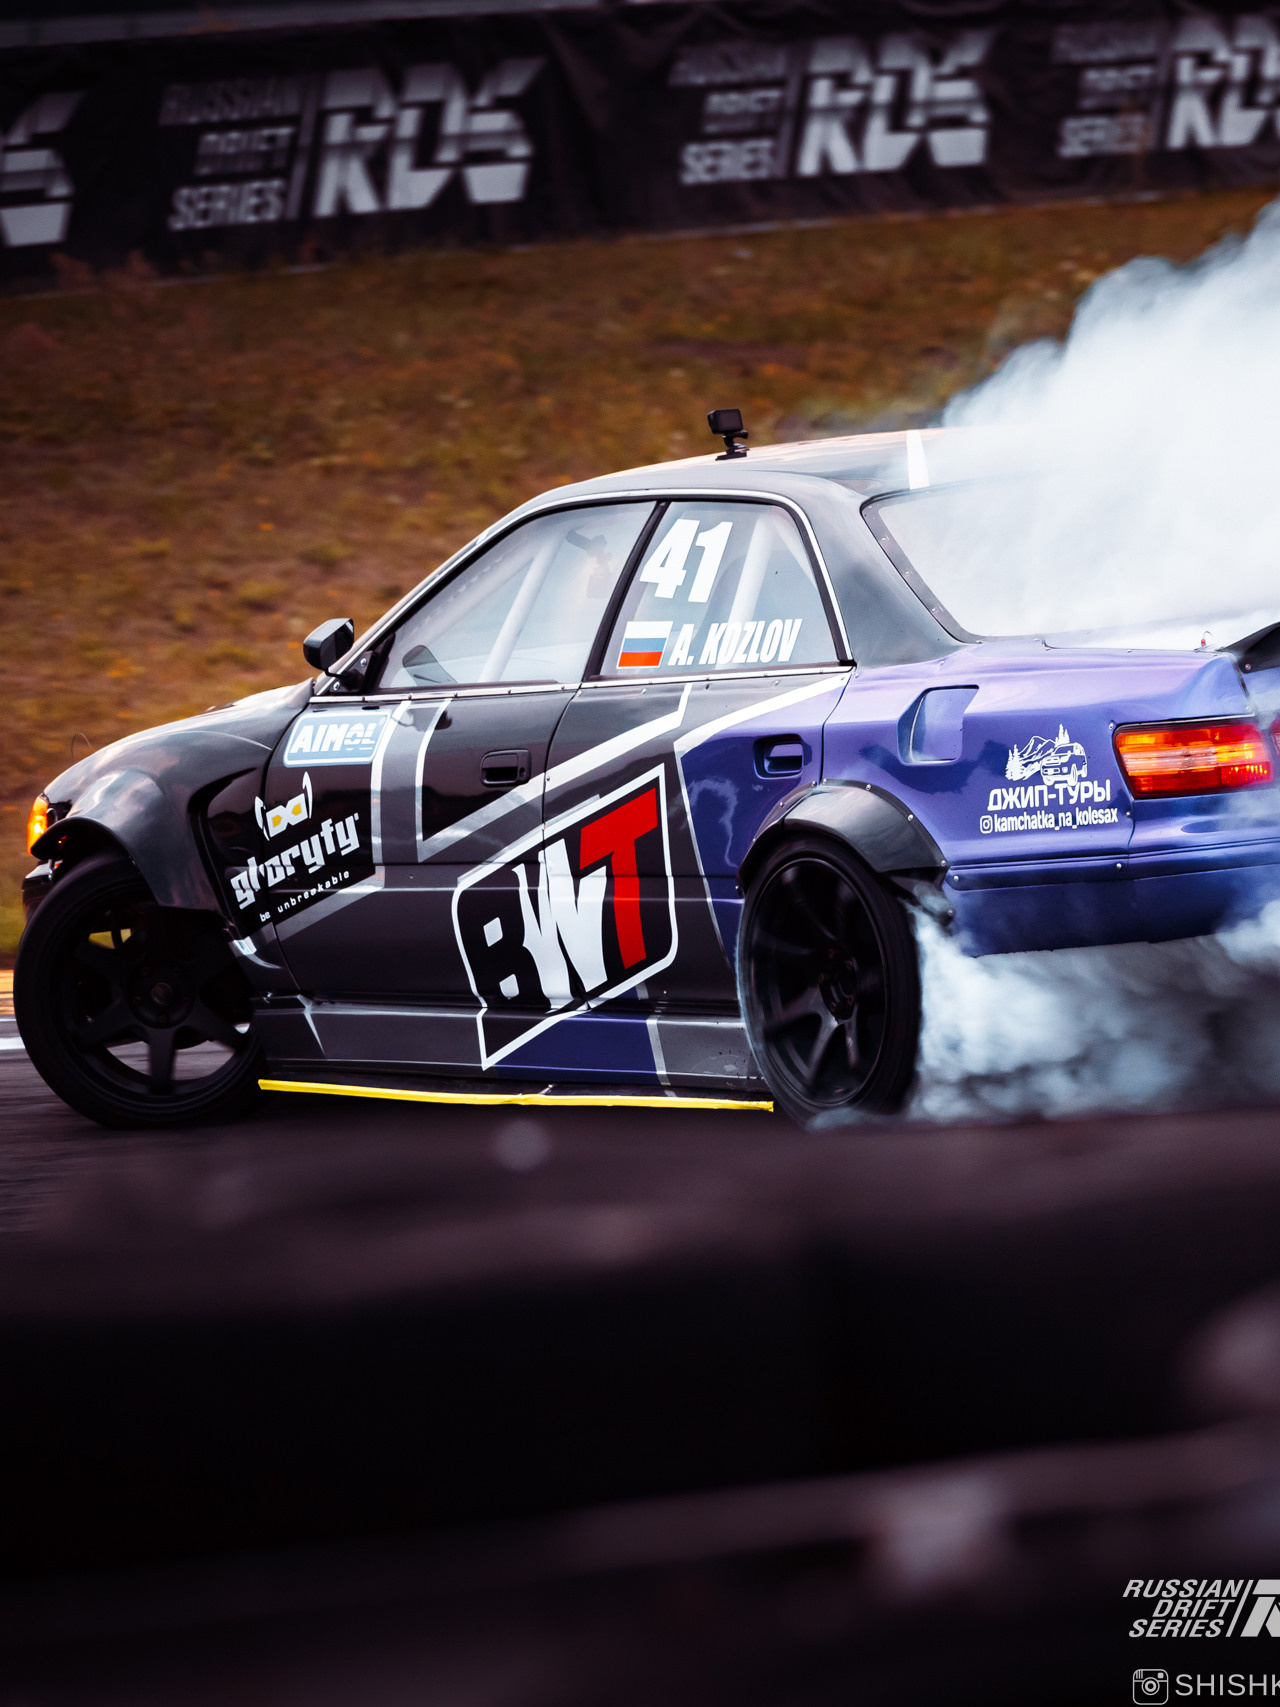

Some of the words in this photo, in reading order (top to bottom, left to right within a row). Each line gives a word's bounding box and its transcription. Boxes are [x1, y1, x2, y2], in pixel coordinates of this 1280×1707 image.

[312, 57, 547, 218] RDS
[168, 178, 286, 231] SERIES
[639, 518, 733, 603] 41
[667, 623, 695, 666] A.
[698, 618, 803, 665] KOZLOV
[289, 722, 378, 754] AIMOL
[987, 779, 1111, 811] ДЖИП-ТУРЫ
[994, 805, 1119, 832] kamchatka_na_kolesax
[259, 911, 271, 922] be
